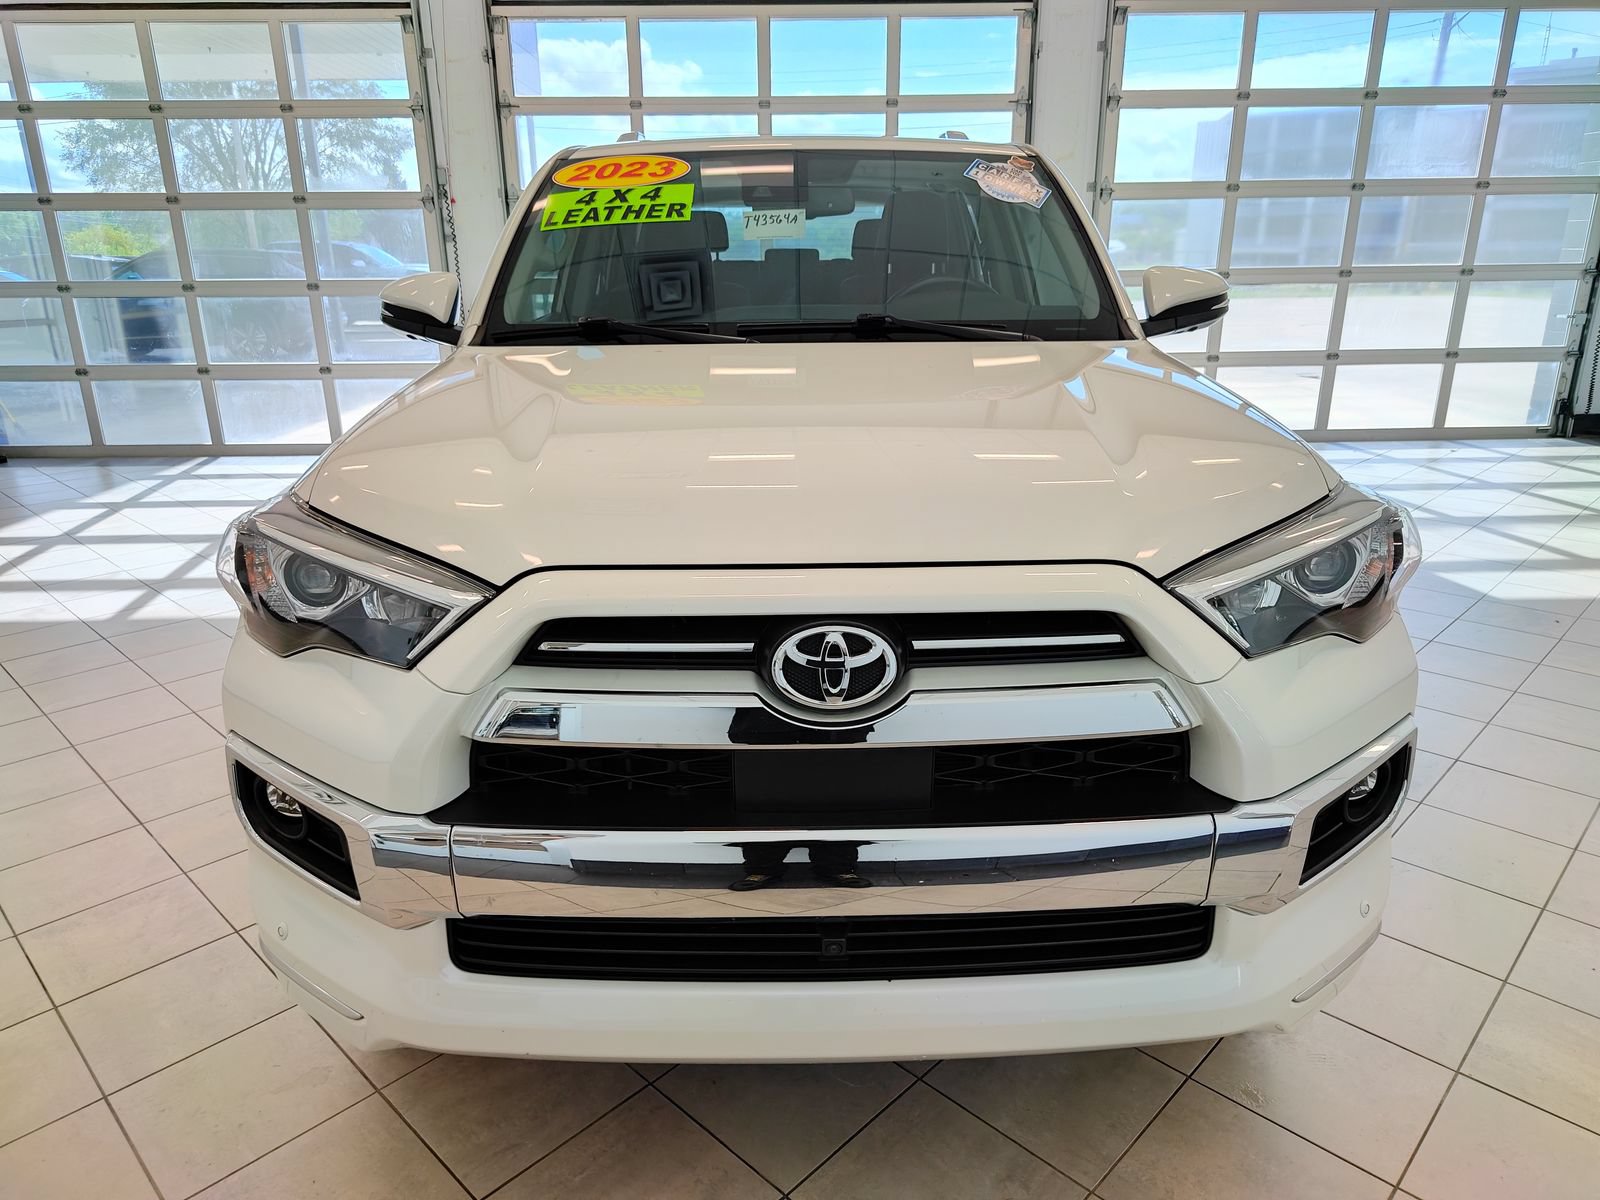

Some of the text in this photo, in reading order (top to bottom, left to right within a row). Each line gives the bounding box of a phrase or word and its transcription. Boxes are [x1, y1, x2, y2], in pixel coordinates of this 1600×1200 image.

[566, 160, 678, 183] 2023
[976, 163, 1044, 195] CARFAX
[983, 174, 1040, 202] OWNER
[544, 202, 687, 227] LEATHER
[744, 213, 798, 229] T43564A
